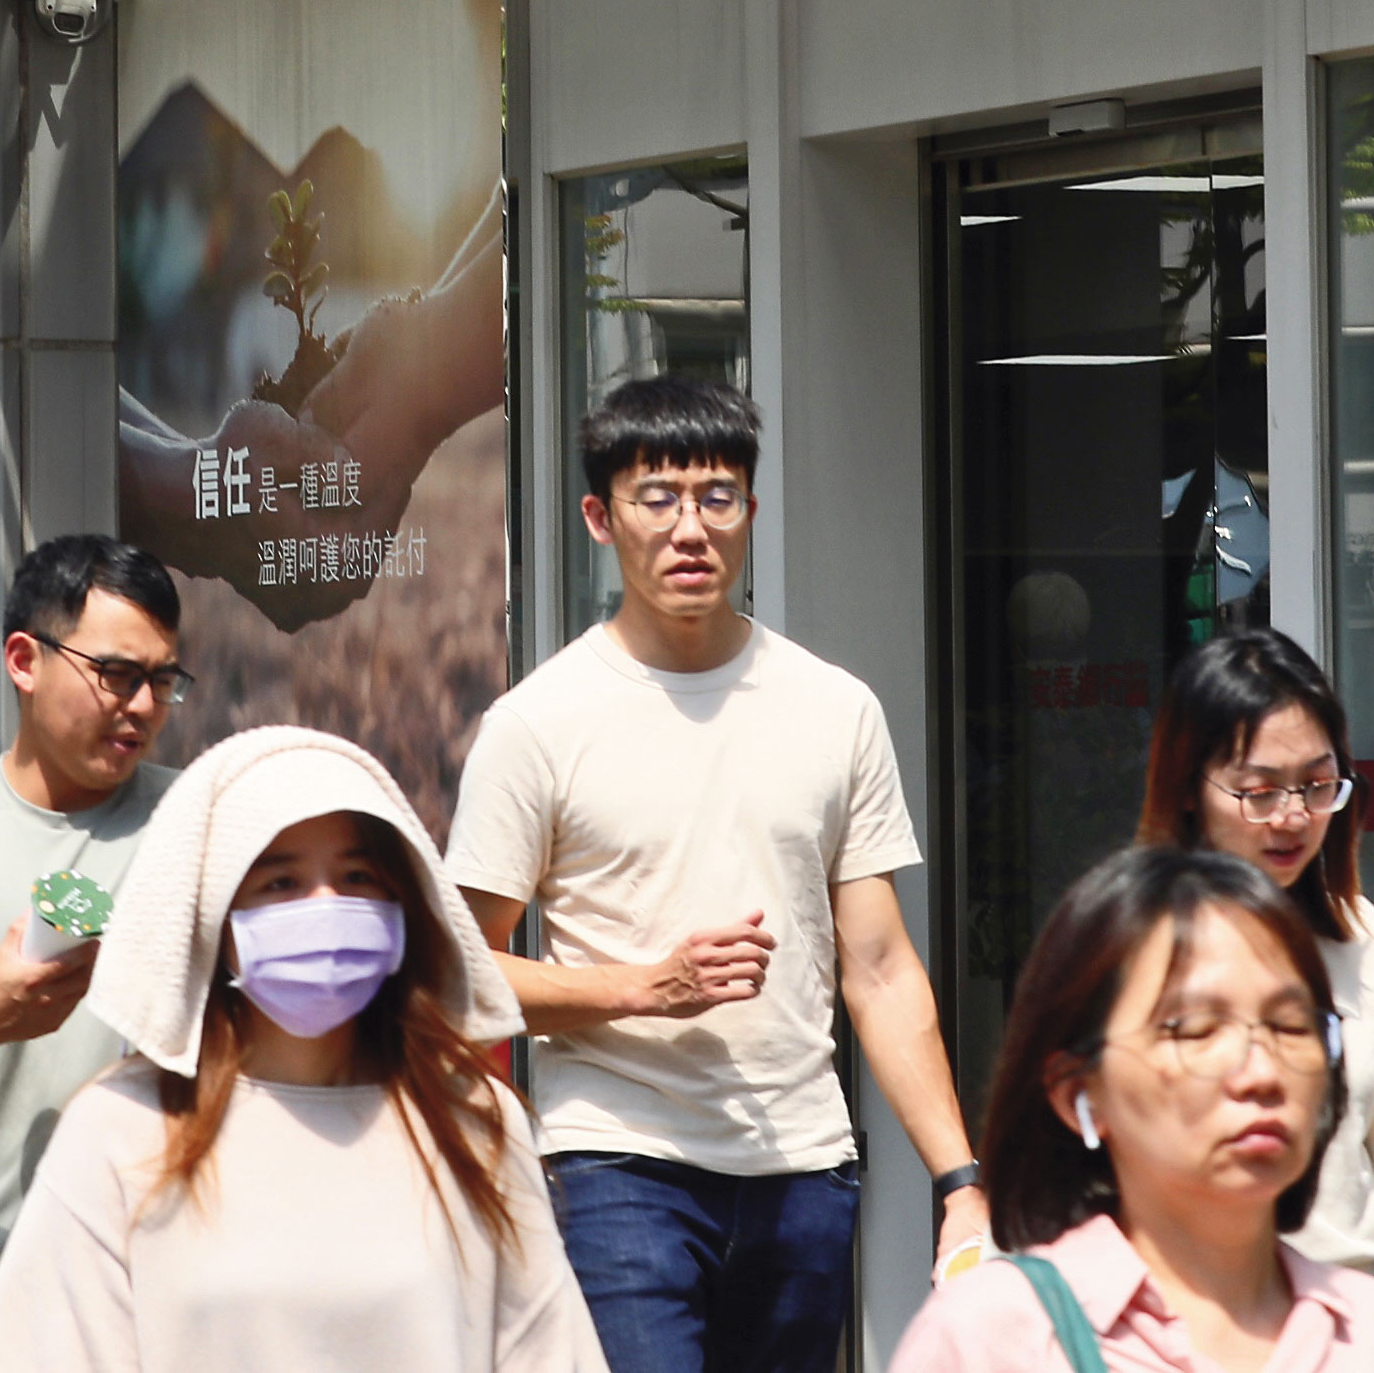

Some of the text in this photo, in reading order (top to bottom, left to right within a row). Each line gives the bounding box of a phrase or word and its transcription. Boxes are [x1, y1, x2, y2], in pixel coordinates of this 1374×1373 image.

[192, 446, 363, 519] 信任 是一種溫度
[257, 527, 427, 587] 溫潤呵護您的託付
